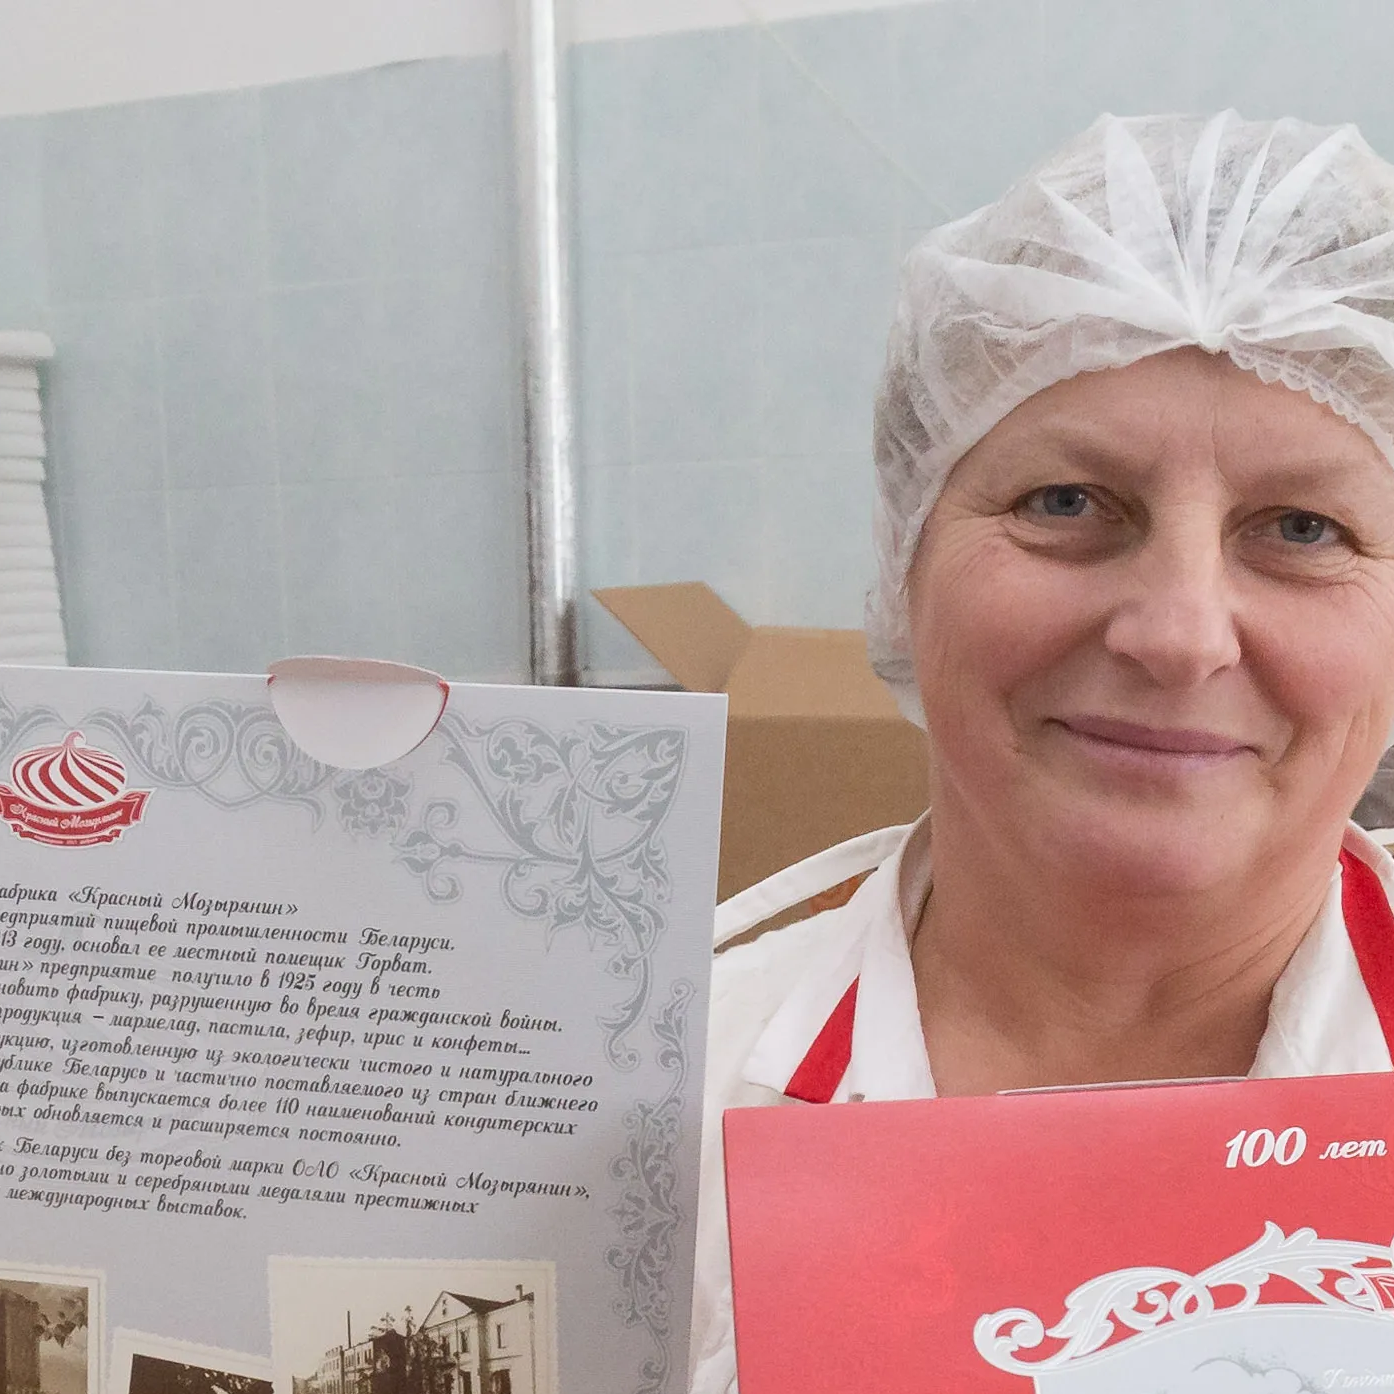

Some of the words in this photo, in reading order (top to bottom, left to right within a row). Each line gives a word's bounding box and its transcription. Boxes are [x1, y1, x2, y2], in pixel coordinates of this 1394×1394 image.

[102, 912, 178, 936] пищевой
[185, 922, 349, 945] промышленности
[358, 926, 455, 955] Беларуси.
[72, 934, 141, 956] основал
[147, 944, 168, 958] ее
[172, 945, 258, 964] местный
[264, 951, 347, 972] помещик
[354, 951, 433, 978] Горват.
[39, 961, 157, 983] предприятие
[171, 970, 254, 991] получило
[259, 968, 271, 989] в
[277, 970, 317, 992] 1925
[321, 980, 364, 1000] году
[369, 974, 381, 996] в
[388, 983, 441, 1000] честь
[149, 992, 273, 1018] разрушенную
[278, 993, 300, 1015] во
[305, 995, 361, 1023] время
[367, 1007, 492, 1029] гражданской
[499, 1008, 563, 1033] войны.
[61, 1035, 199, 1065] изготовленную
[205, 1048, 225, 1068] из
[231, 1050, 351, 1071] экологически
[359, 1058, 433, 1077] чистого
[439, 1064, 452, 1078] и
[458, 1066, 594, 1088] натурального
[362, 1031, 406, 1051] ирис
[412, 1034, 424, 1048] и
[61, 1056, 148, 1085] Беларусь
[154, 1068, 166, 1082] и
[174, 1069, 258, 1089] частично
[264, 1073, 404, 1099] поставляемого
[411, 1087, 431, 1107] из
[438, 1089, 497, 1109] стран
[504, 1089, 599, 1113] ближнего
[16, 1078, 89, 1103] фабрике
[94, 1080, 212, 1109] выпускается
[217, 1093, 268, 1113] более
[275, 1096, 300, 1115] 110
[305, 1102, 436, 1126] наименований
[443, 1114, 579, 1138] кондитерских
[32, 1102, 144, 1128] обновляется
[151, 1116, 163, 1130] и
[168, 1117, 290, 1140] расширяется
[297, 1127, 402, 1148] постоянно.
[12, 1136, 99, 1164] Беларуси
[105, 1144, 132, 1168] без
[139, 1148, 222, 1172] торговой
[228, 1159, 285, 1179] марки
[291, 1158, 340, 1180] ОАО
[1224, 1126, 1307, 1169] 100
[1318, 1138, 1388, 1161] лет
[4, 1187, 151, 1213] международных
[156, 1192, 247, 1220] выставок.
[17, 1165, 110, 1185] золотыми
[116, 1173, 128, 1186] и
[134, 1173, 251, 1197] серебряными
[256, 1185, 347, 1205] медалями
[353, 1192, 480, 1215] престижных
